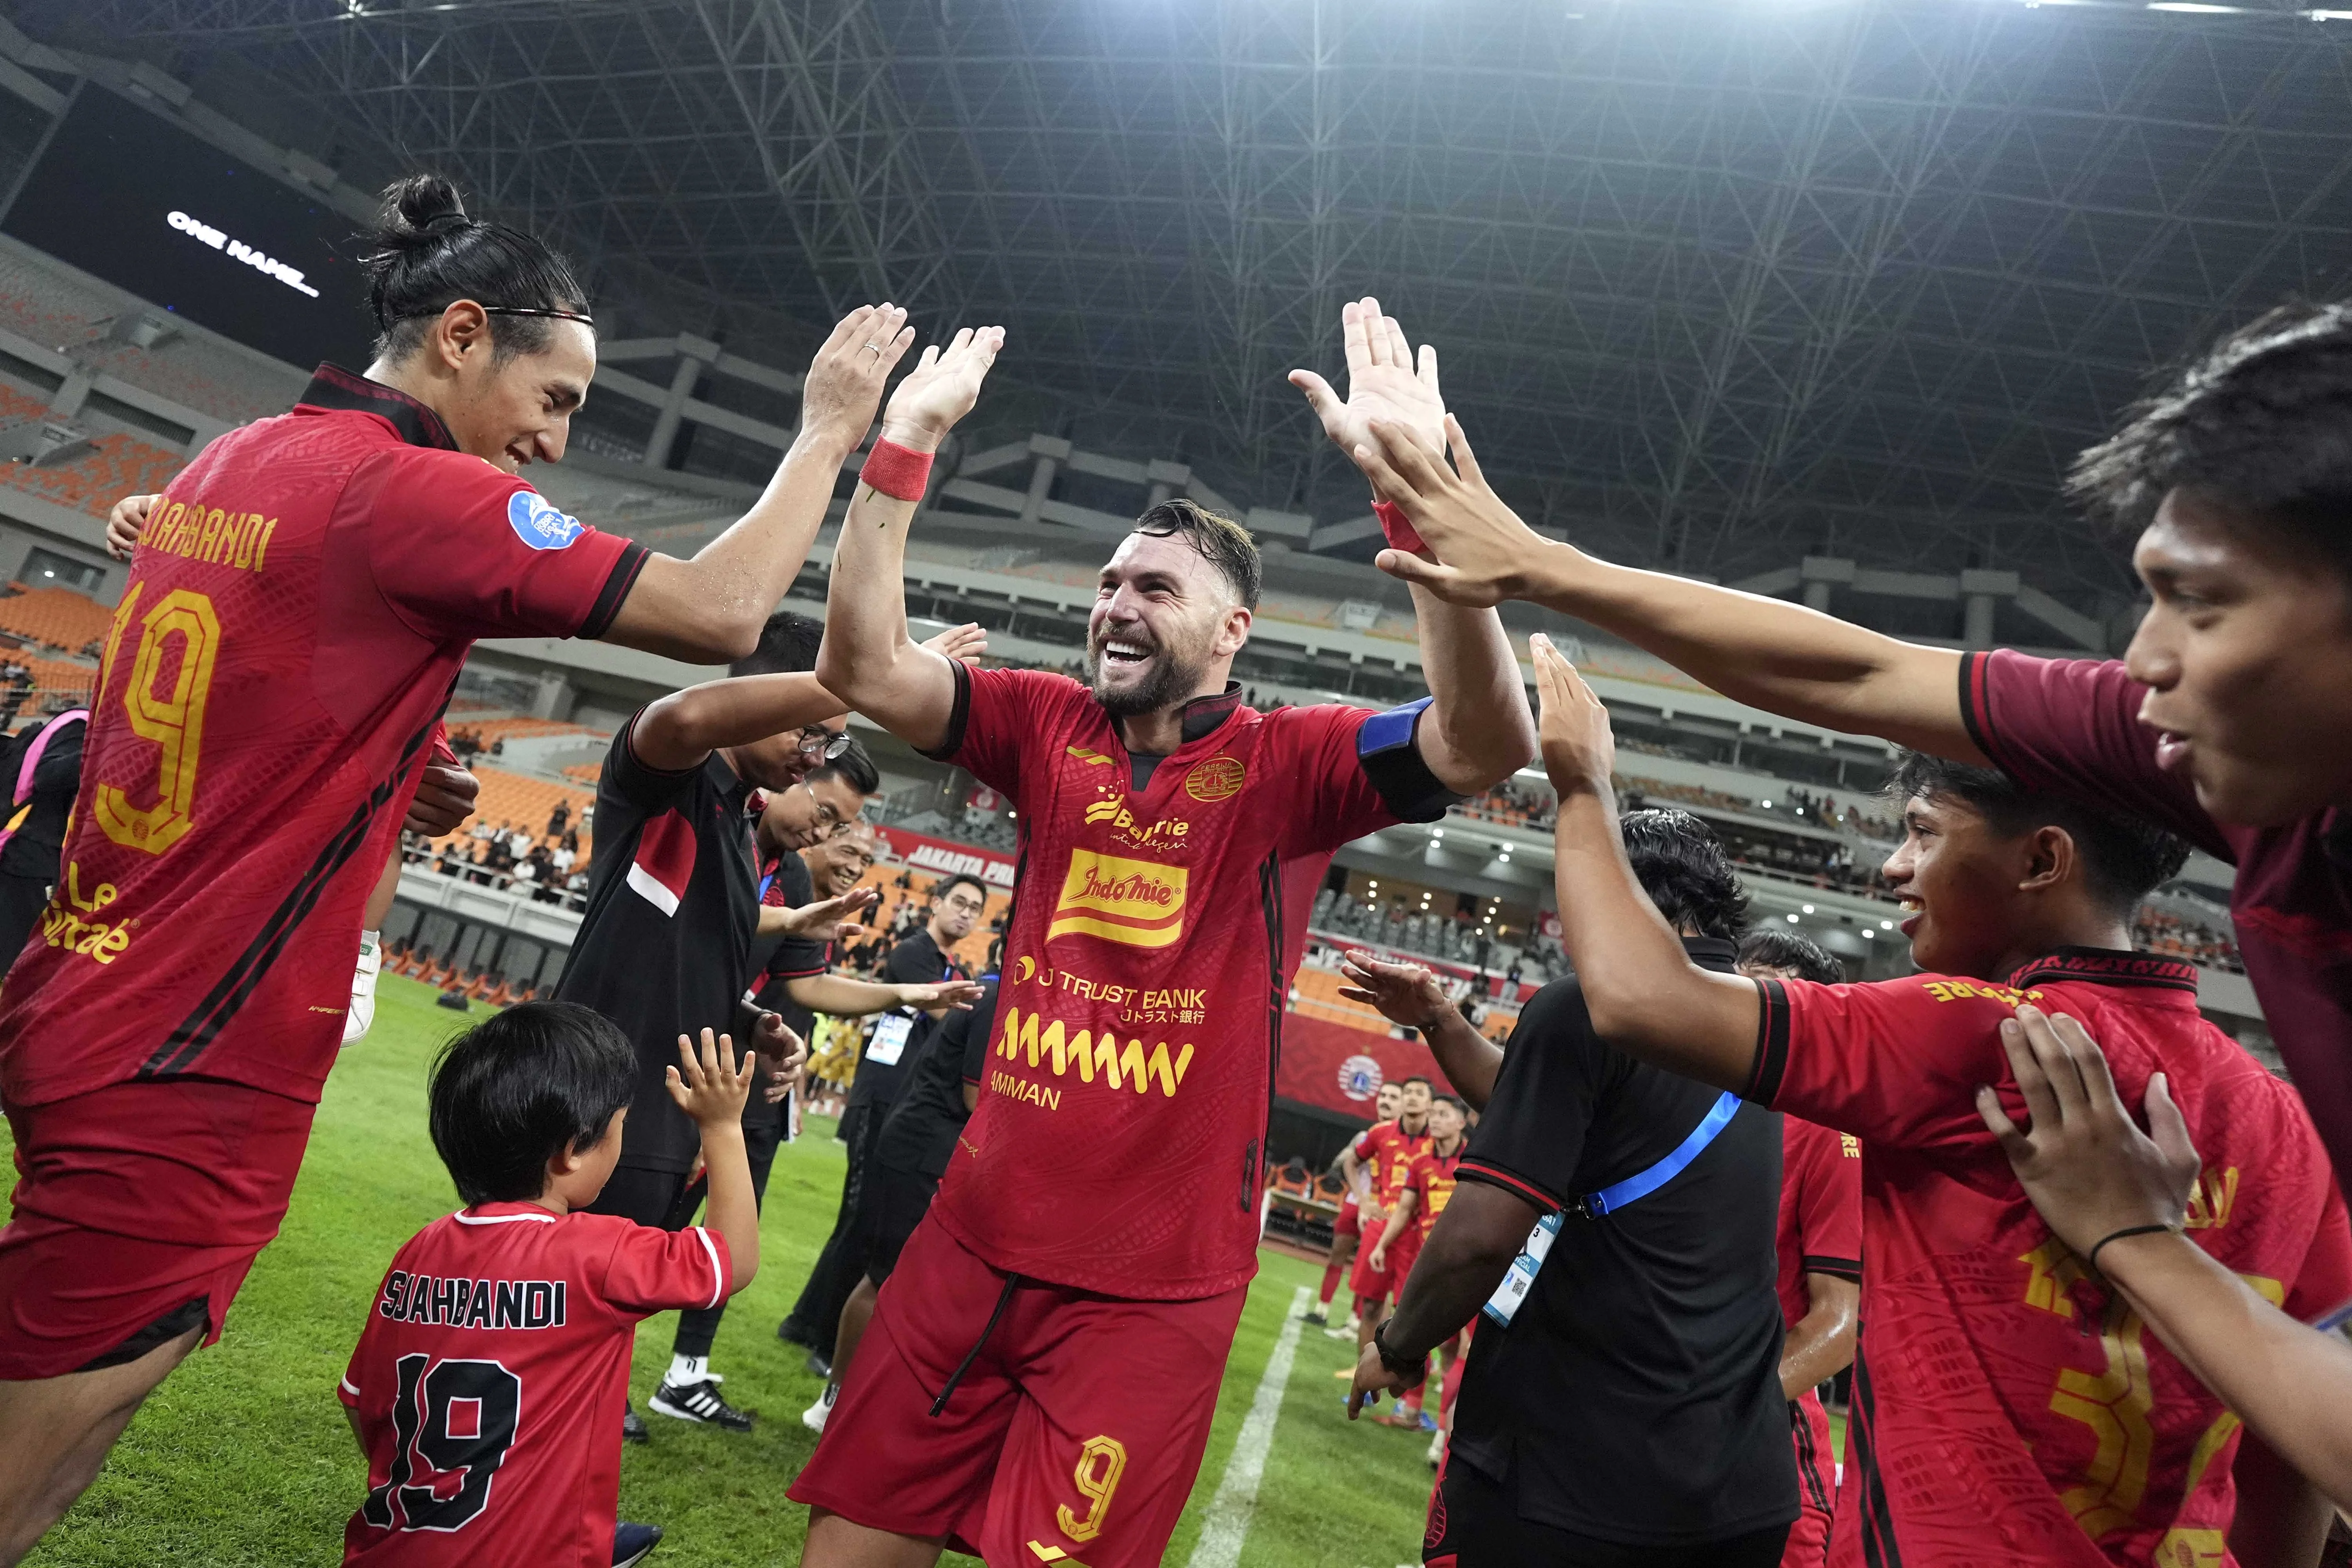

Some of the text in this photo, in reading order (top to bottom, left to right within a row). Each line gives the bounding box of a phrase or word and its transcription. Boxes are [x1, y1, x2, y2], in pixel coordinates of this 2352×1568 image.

[167, 211, 228, 250] ONE
[137, 497, 278, 572] JAHBANDI
[540, 512, 556, 526] BRI
[93, 580, 221, 855] 19
[1200, 762, 1233, 770] PERSIJA
[906, 844, 985, 876] JAKARTA
[68, 861, 117, 913] Le
[1038, 968, 1207, 1010] J TRUST BANK
[991, 1070, 1062, 1111] AMMAN
[1514, 1256, 1531, 1272] FFICIAL
[379, 1270, 566, 1330] SJAHBANDI
[361, 1352, 521, 1532] 19
[1056, 1435, 1128, 1543] 9
